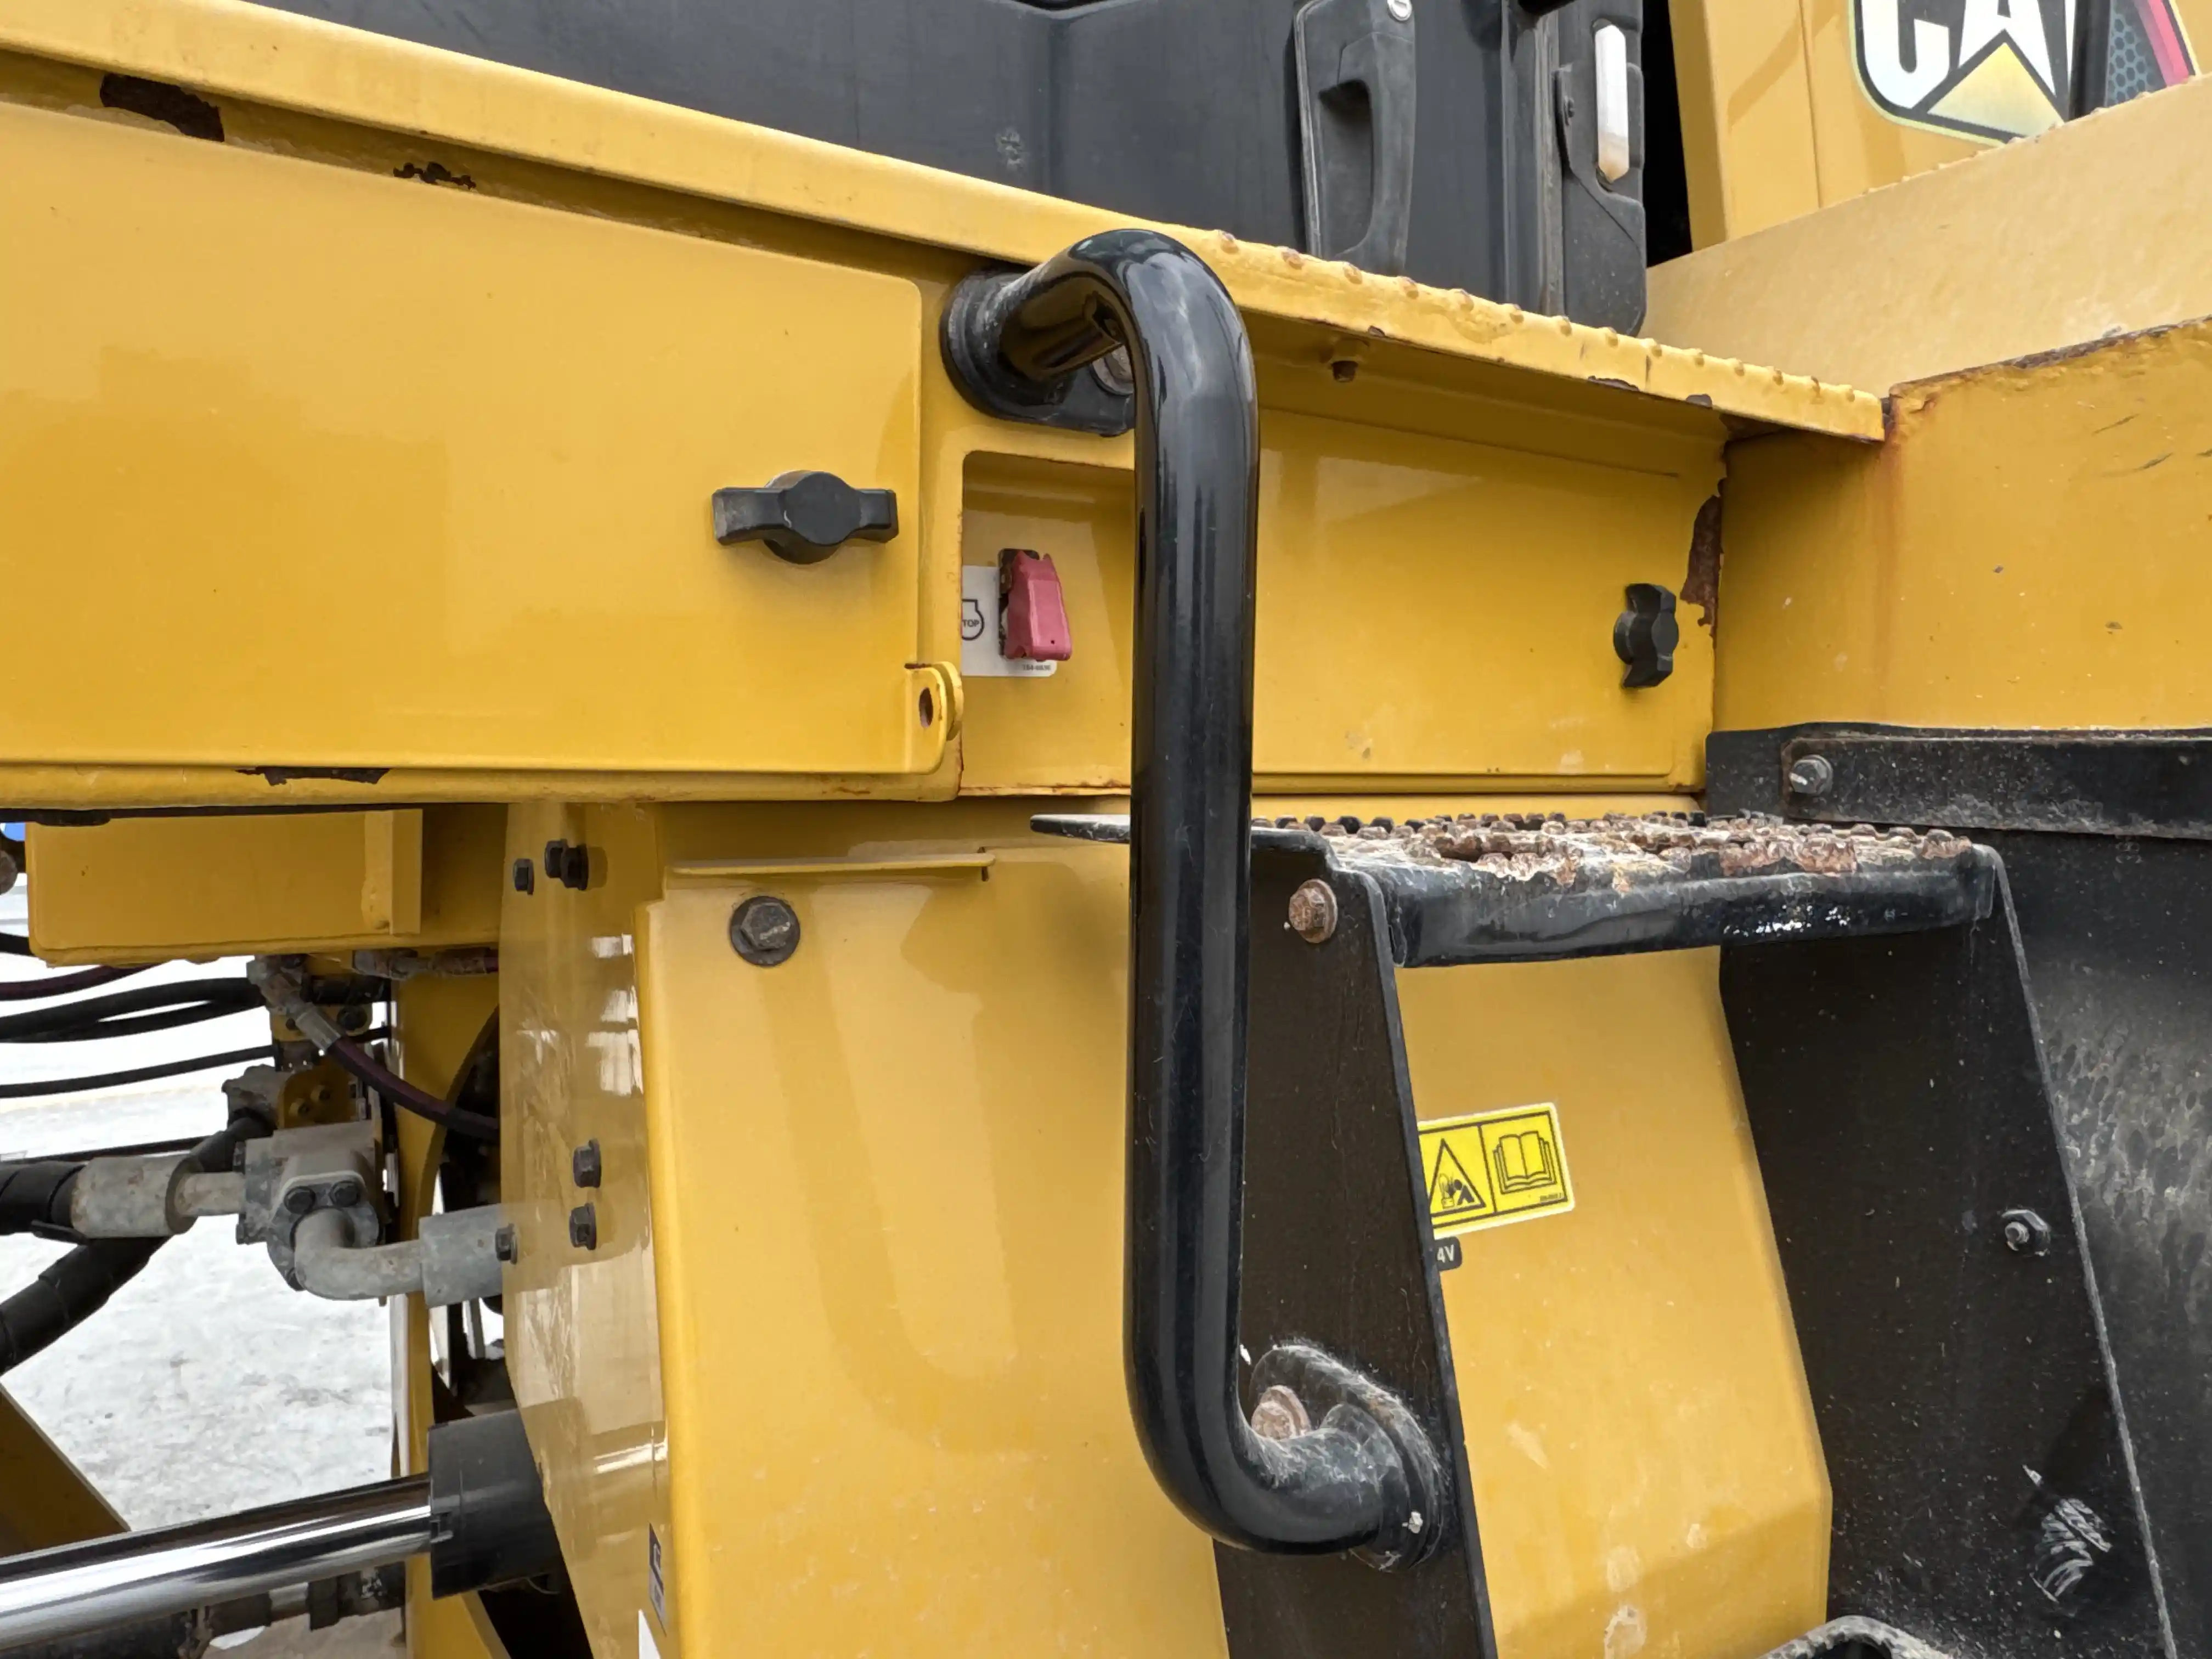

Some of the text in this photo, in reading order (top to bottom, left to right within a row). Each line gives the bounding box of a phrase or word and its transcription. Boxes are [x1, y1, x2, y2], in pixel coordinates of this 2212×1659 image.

[1861, 0, 2076, 109] CA
[961, 619, 980, 628] TOP
[1436, 1244, 1455, 1263] 4V
